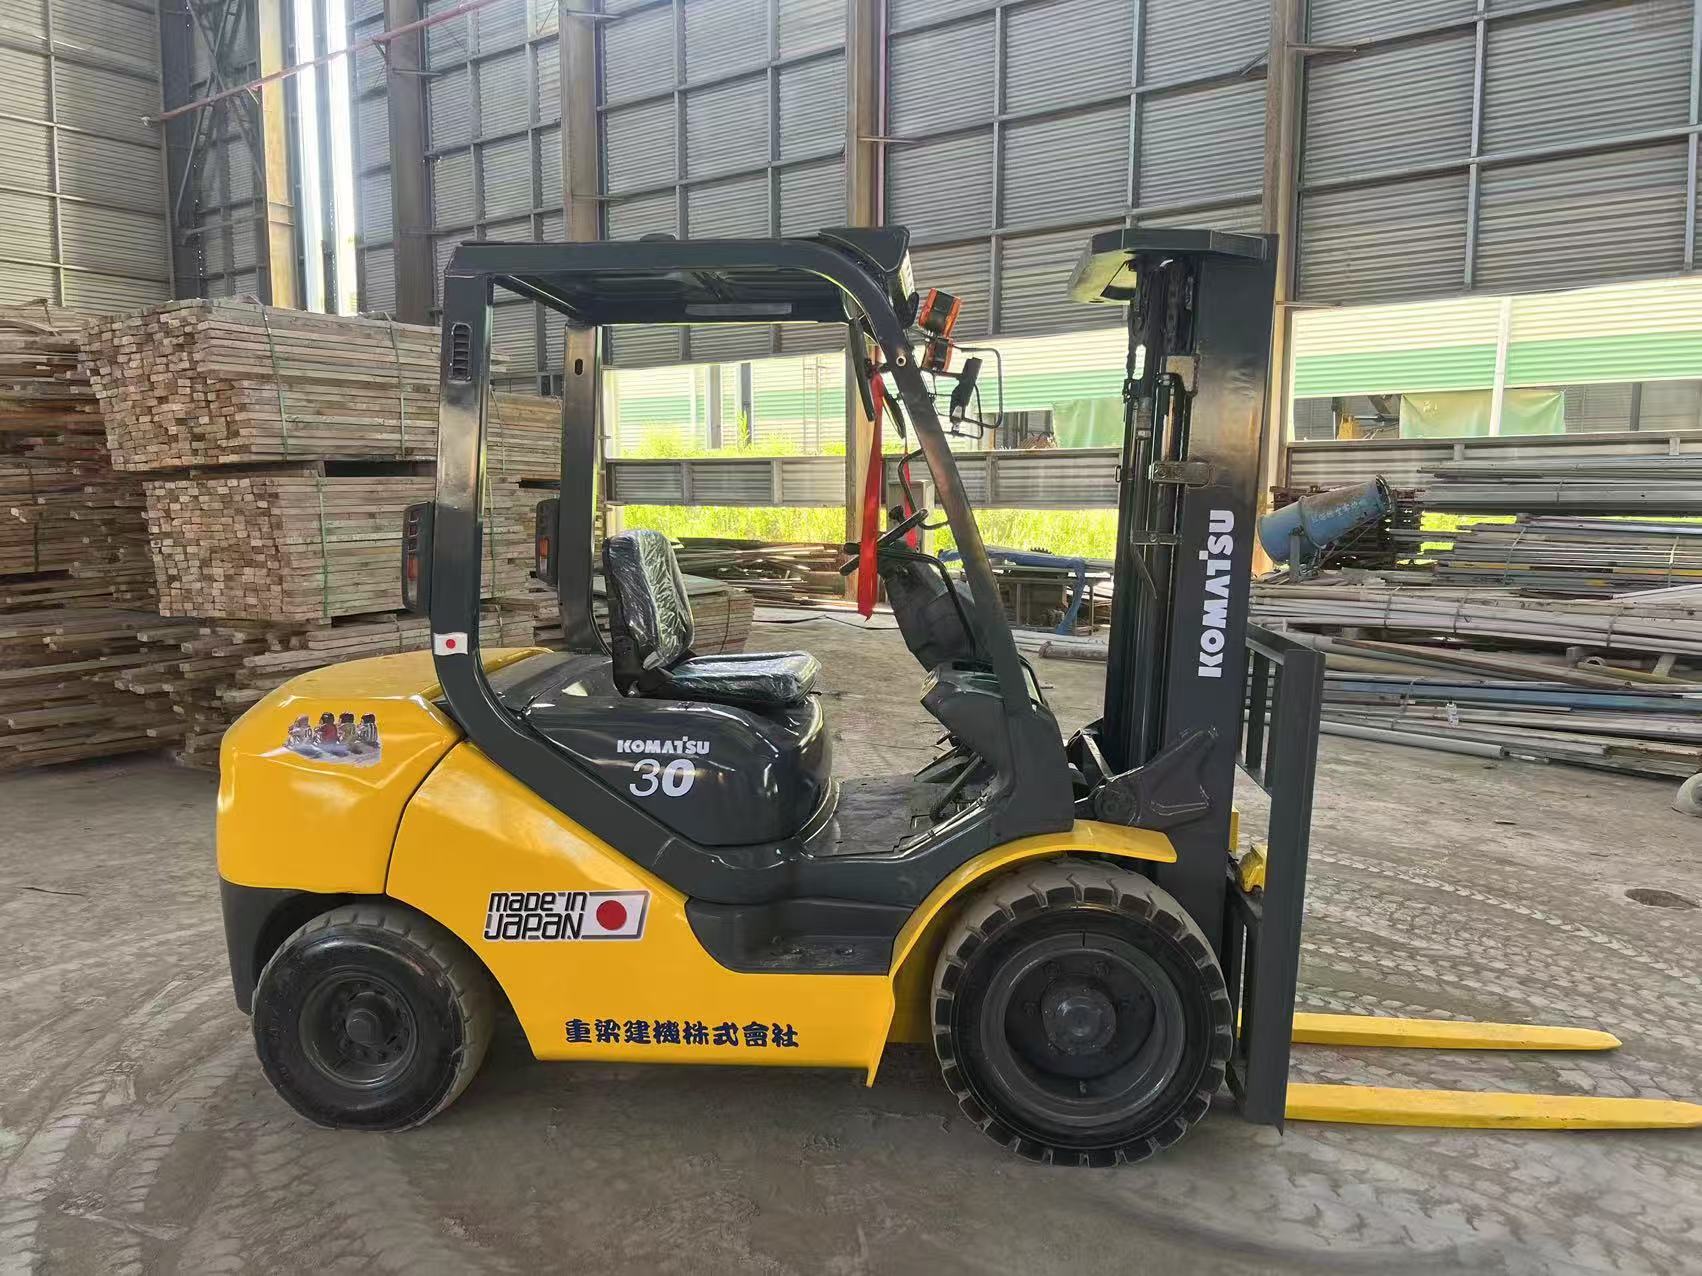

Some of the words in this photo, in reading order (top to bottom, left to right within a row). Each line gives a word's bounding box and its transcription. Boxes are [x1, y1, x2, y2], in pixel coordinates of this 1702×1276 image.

[1198, 509, 1235, 678] KOMATSU
[616, 736, 710, 754] KOMATSU
[629, 758, 696, 797] 30
[565, 1018, 799, 1047] 重梁建機株式會社
